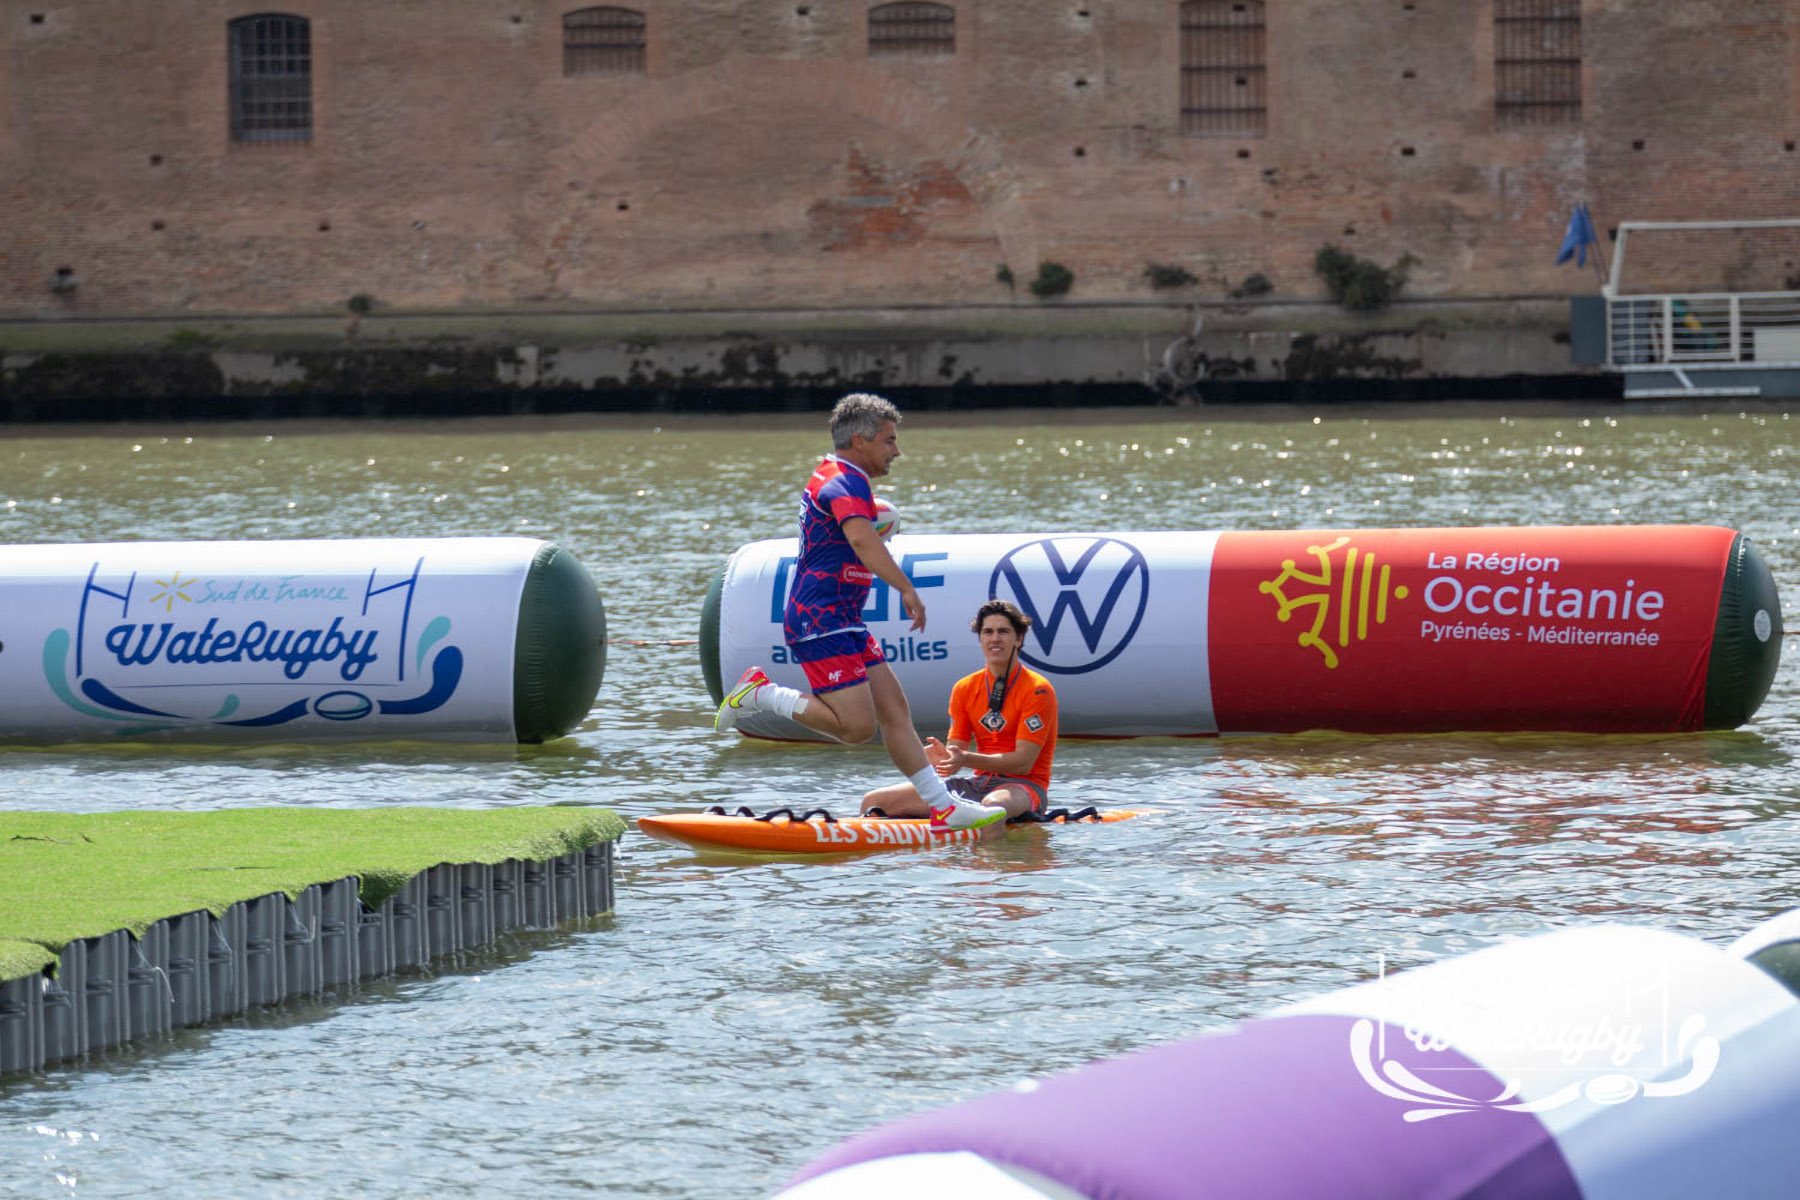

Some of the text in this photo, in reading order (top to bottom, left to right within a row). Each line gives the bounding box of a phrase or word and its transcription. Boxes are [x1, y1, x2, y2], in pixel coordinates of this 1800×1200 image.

[1427, 551, 1561, 575] La Région
[194, 575, 350, 604] Sud de France
[1423, 576, 1665, 622] Occitanie
[1420, 619, 1512, 643] Pyrénées
[1526, 624, 1661, 648] Méditerranée
[104, 615, 379, 683] WateRugby
[770, 636, 949, 665] abiles
[812, 821, 859, 843] LES
